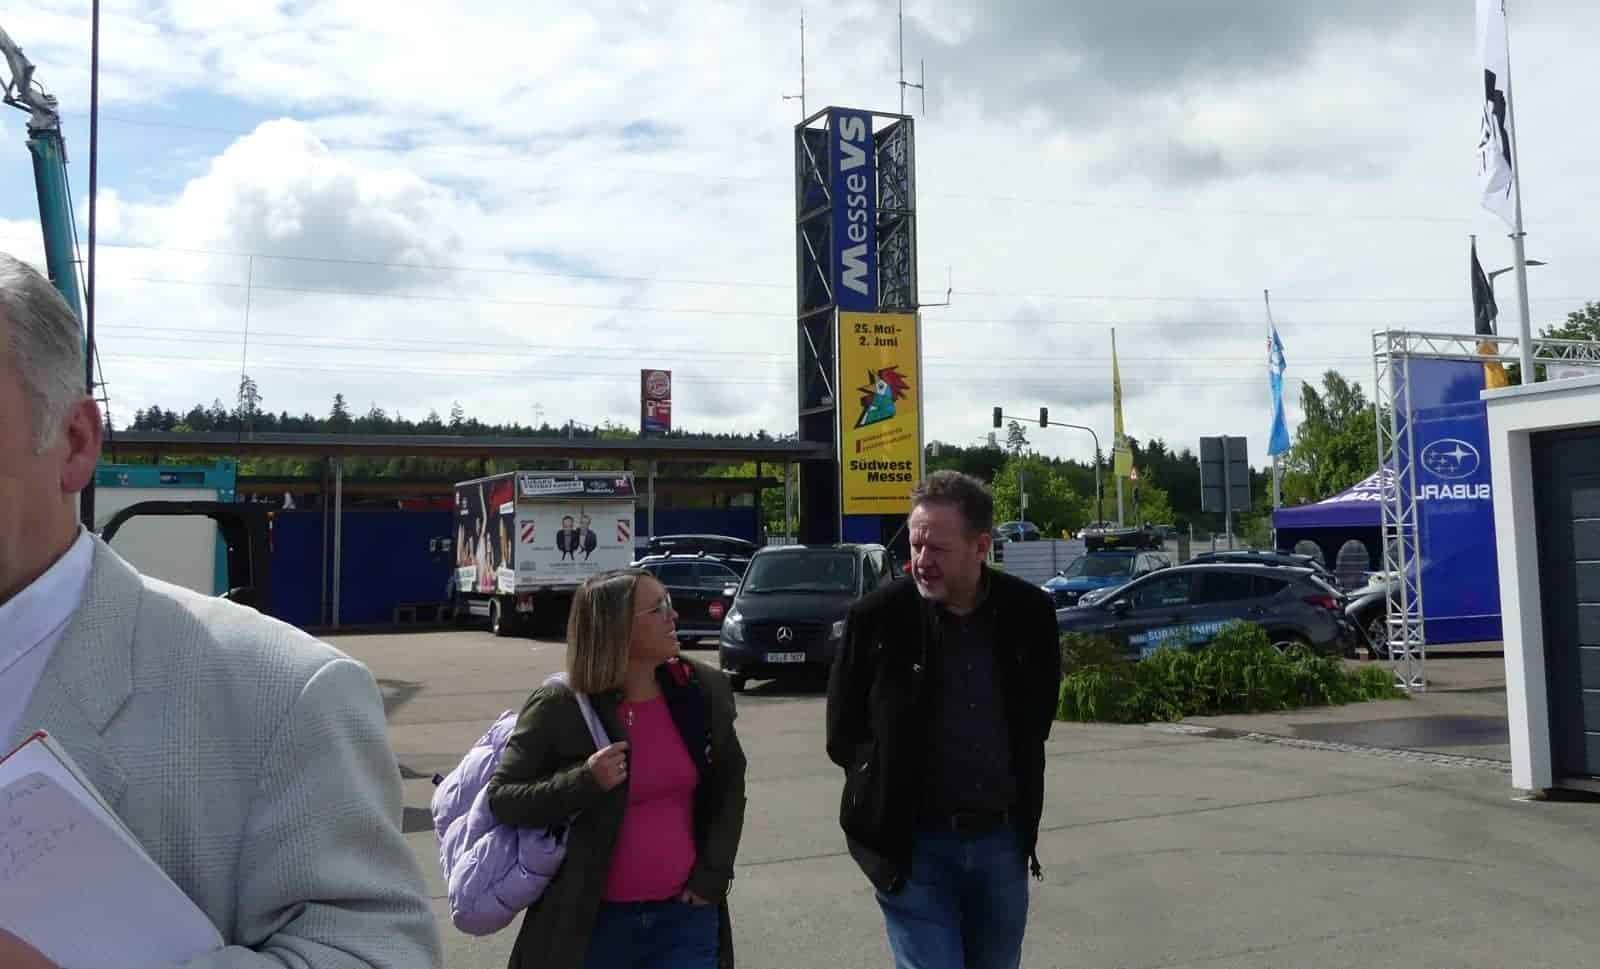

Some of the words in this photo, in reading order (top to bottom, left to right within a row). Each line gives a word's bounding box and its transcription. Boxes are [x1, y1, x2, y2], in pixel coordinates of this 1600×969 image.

[855, 323, 872, 334] 25.
[859, 336, 870, 346] 2.
[873, 336, 898, 347] Juni
[850, 459, 912, 471] Südwest
[867, 471, 912, 482] Messe
